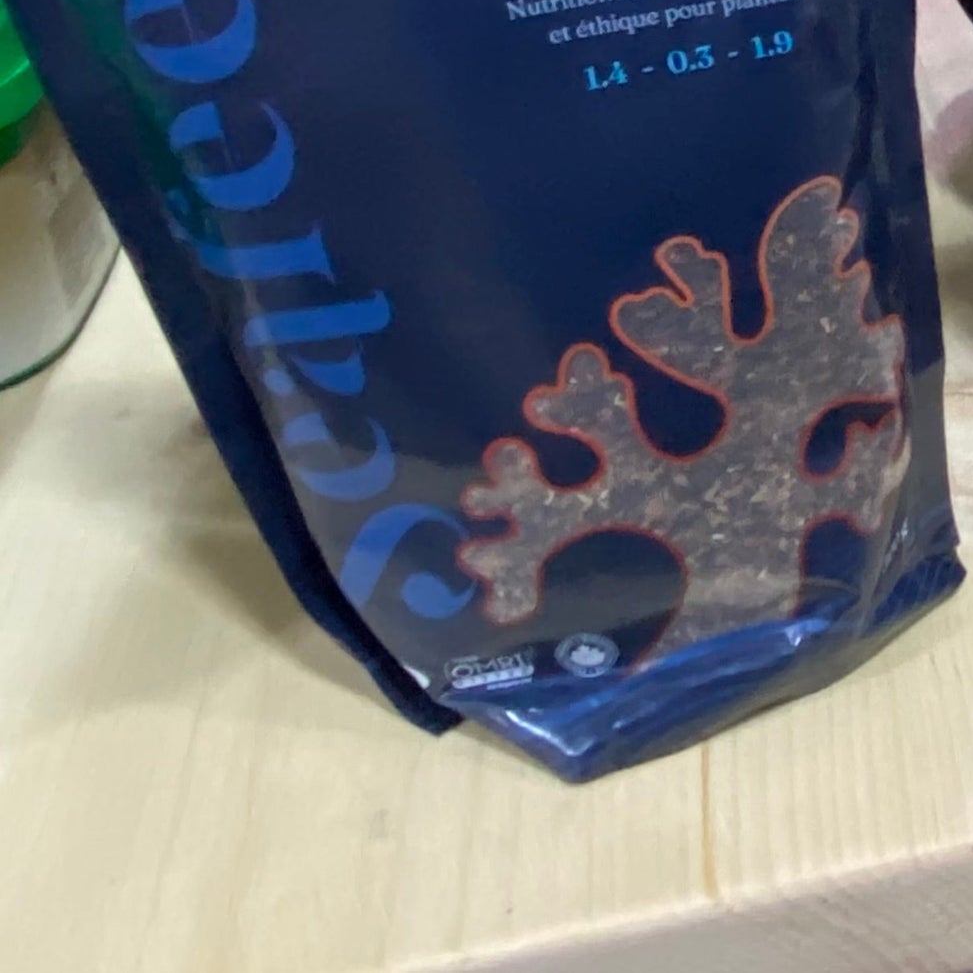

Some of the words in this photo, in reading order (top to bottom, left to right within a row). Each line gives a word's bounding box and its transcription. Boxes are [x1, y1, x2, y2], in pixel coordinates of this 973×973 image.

[548, 24, 571, 45] et
[575, 5, 660, 39] éthique
[582, 60, 629, 91] 1.4
[666, 44, 715, 75] 0.3
[751, 30, 794, 60] 1.9
